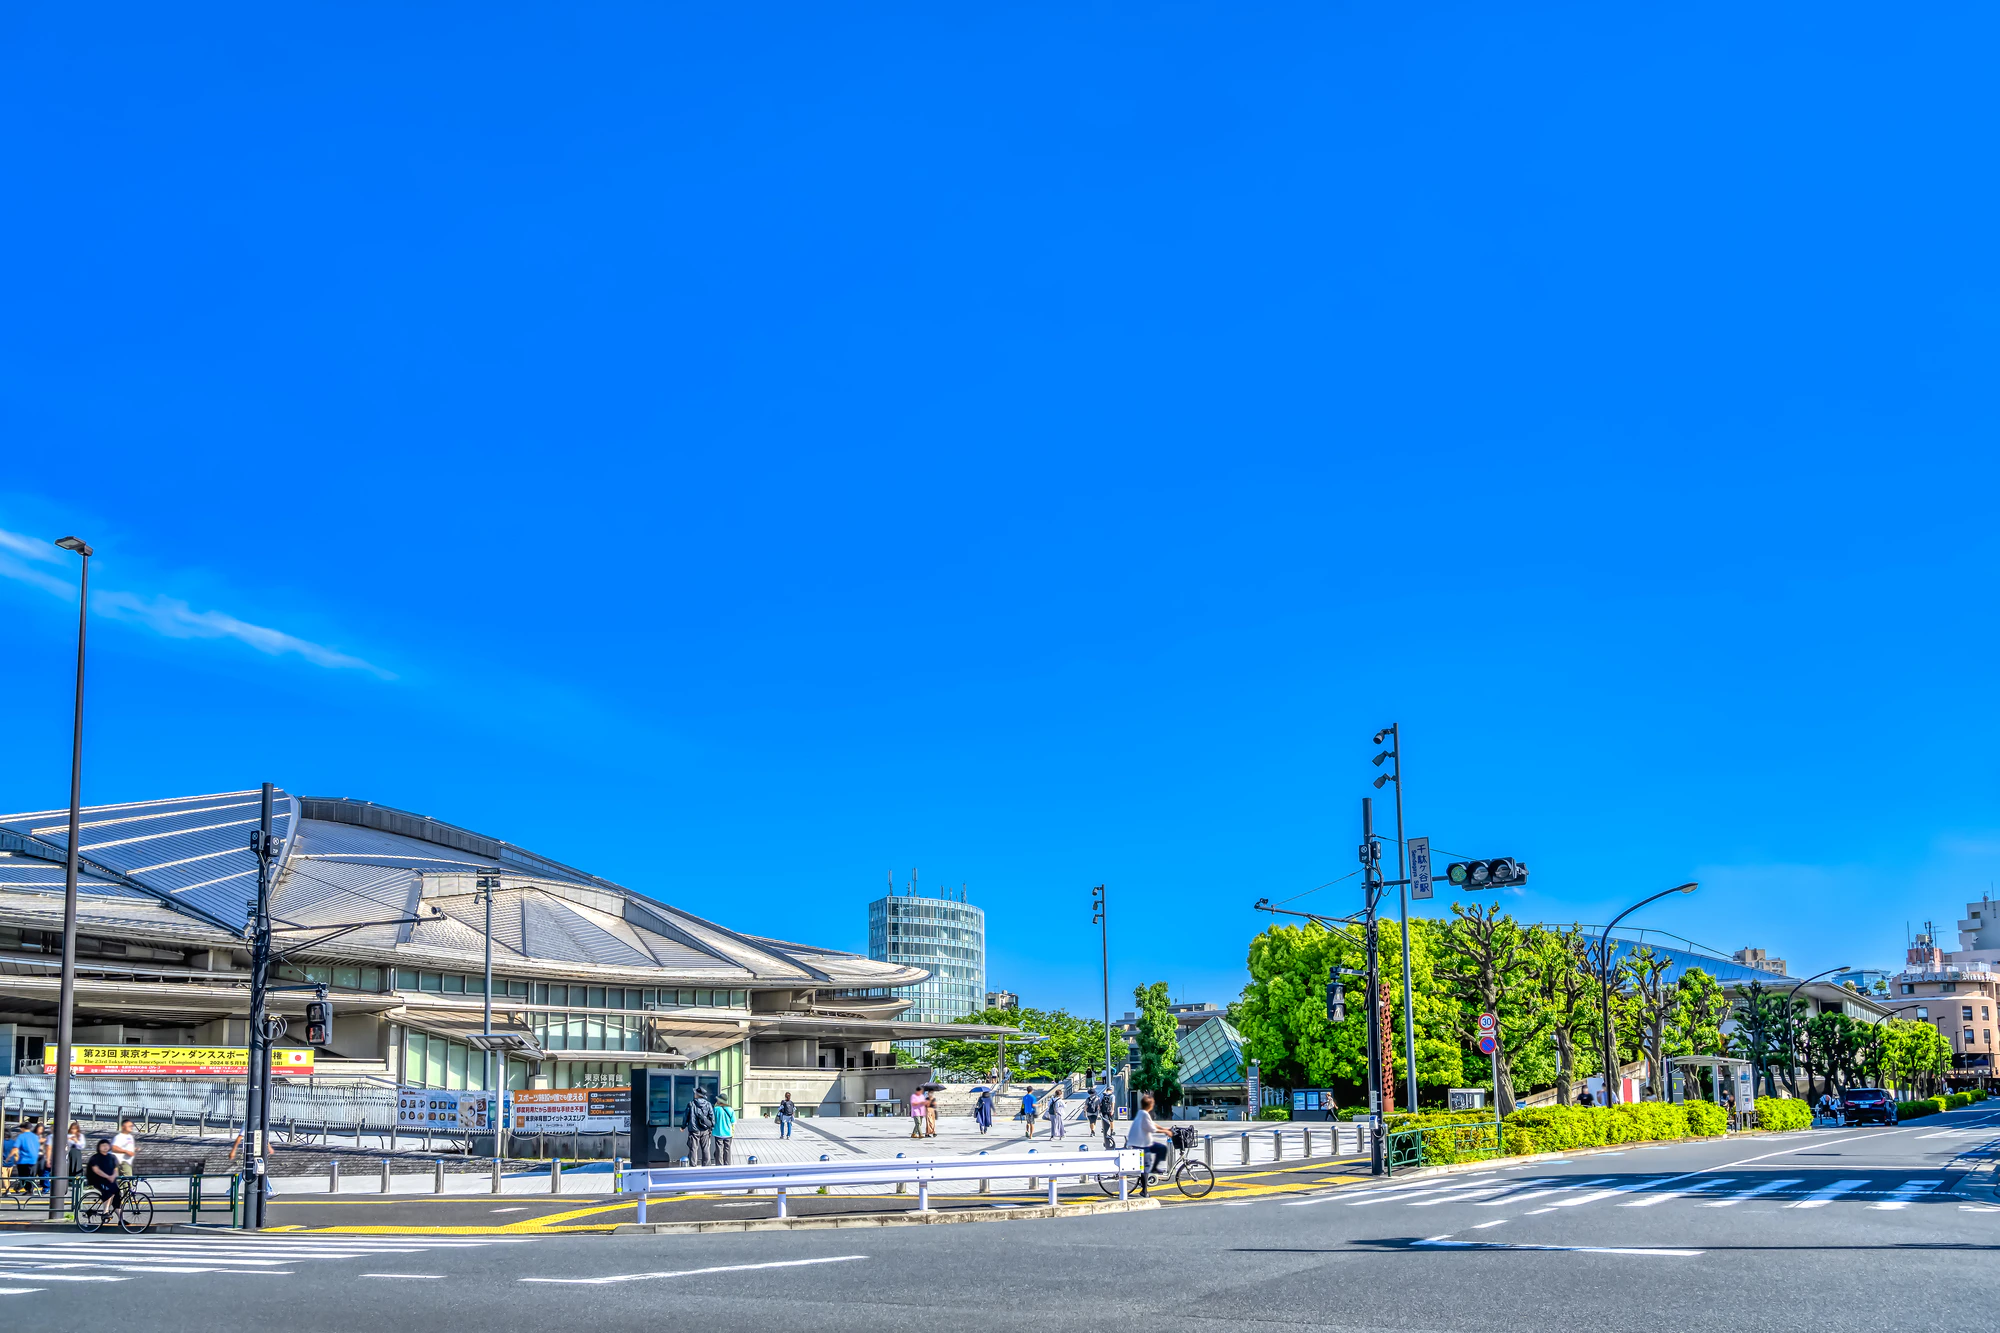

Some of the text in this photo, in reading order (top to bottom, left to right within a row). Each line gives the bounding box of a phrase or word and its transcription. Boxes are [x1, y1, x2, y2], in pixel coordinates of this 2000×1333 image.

[1417, 844, 1430, 893] 千駄ヶ谷駅
[1481, 1018, 1492, 1026] 30
[83, 1048, 117, 1058] 第23回
[584, 1073, 623, 1082] 東京体育館
